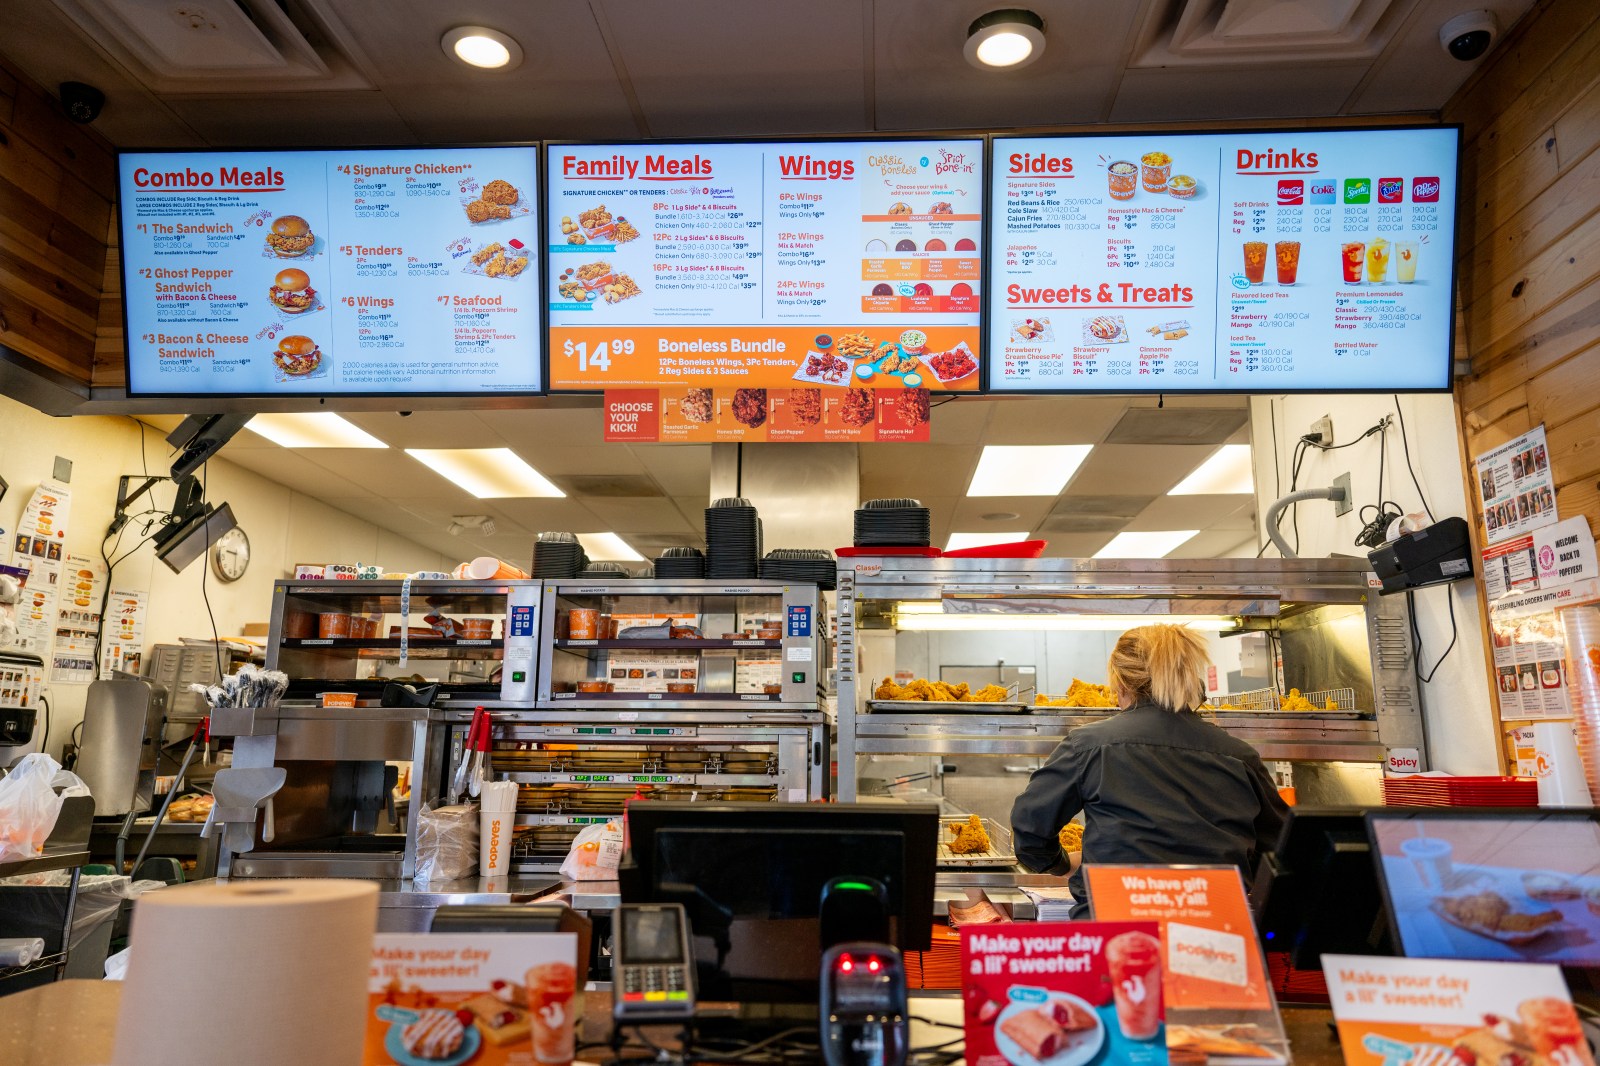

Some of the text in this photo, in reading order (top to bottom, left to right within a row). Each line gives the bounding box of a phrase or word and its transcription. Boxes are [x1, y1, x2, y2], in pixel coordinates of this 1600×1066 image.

[868, 156, 903, 167] Classic
[942, 154, 966, 164] Spicy
[1009, 153, 1073, 173] Sides
[1237, 148, 1318, 169] Drinks
[337, 165, 350, 175] #4
[354, 165, 411, 177] Signature
[563, 155, 712, 179] Family Meals
[779, 155, 854, 179] Wings
[881, 165, 916, 175] Boneless
[936, 163, 973, 175] Bone-in
[134, 167, 284, 187] Combo Meals
[797, 193, 822, 202] Wings
[1381, 187, 1399, 196] Fanta
[137, 224, 233, 233] #1 The Sandwich
[798, 233, 824, 241] Wings
[340, 246, 402, 255] #5 Tenders
[139, 268, 233, 280] #2 Ghost Pepper
[156, 283, 211, 292] Sandwich
[799, 281, 825, 290] Wings
[1007, 283, 1193, 303] Sweets & Treats
[342, 297, 394, 308] #6 Wings
[437, 296, 501, 305] #7 Seafood
[142, 334, 248, 344] #3 Bacon & Cheese
[658, 338, 785, 353] Boneless Bundle
[159, 348, 214, 358] Sandwich
[659, 358, 798, 369] 12Pc Boneless Wings, 3Pc Tenders,
[659, 367, 749, 377] 2 Reg Sides & 3 Sauces
[610, 403, 653, 412] CHOOSE
[610, 413, 639, 422] YOUR
[610, 423, 637, 433] KICK!
[1555, 535, 1578, 548] WELCOME
[1560, 550, 1580, 562] BACK TO
[1497, 590, 1571, 610] ASSEMBLING ORDERS WITH CARE
[1390, 756, 1417, 768] Spicy
[1122, 877, 1208, 893] We have gift
[1130, 892, 1208, 908] cards, y'all!
[970, 934, 1103, 955] Make your day
[420, 951, 456, 963] your
[462, 948, 490, 962] day
[971, 960, 982, 974] a
[1009, 954, 1091, 972] sweeter!
[405, 964, 478, 977] sweeter!
[1340, 970, 1469, 991] Make your day
[1384, 994, 1463, 1008] sweeter!
